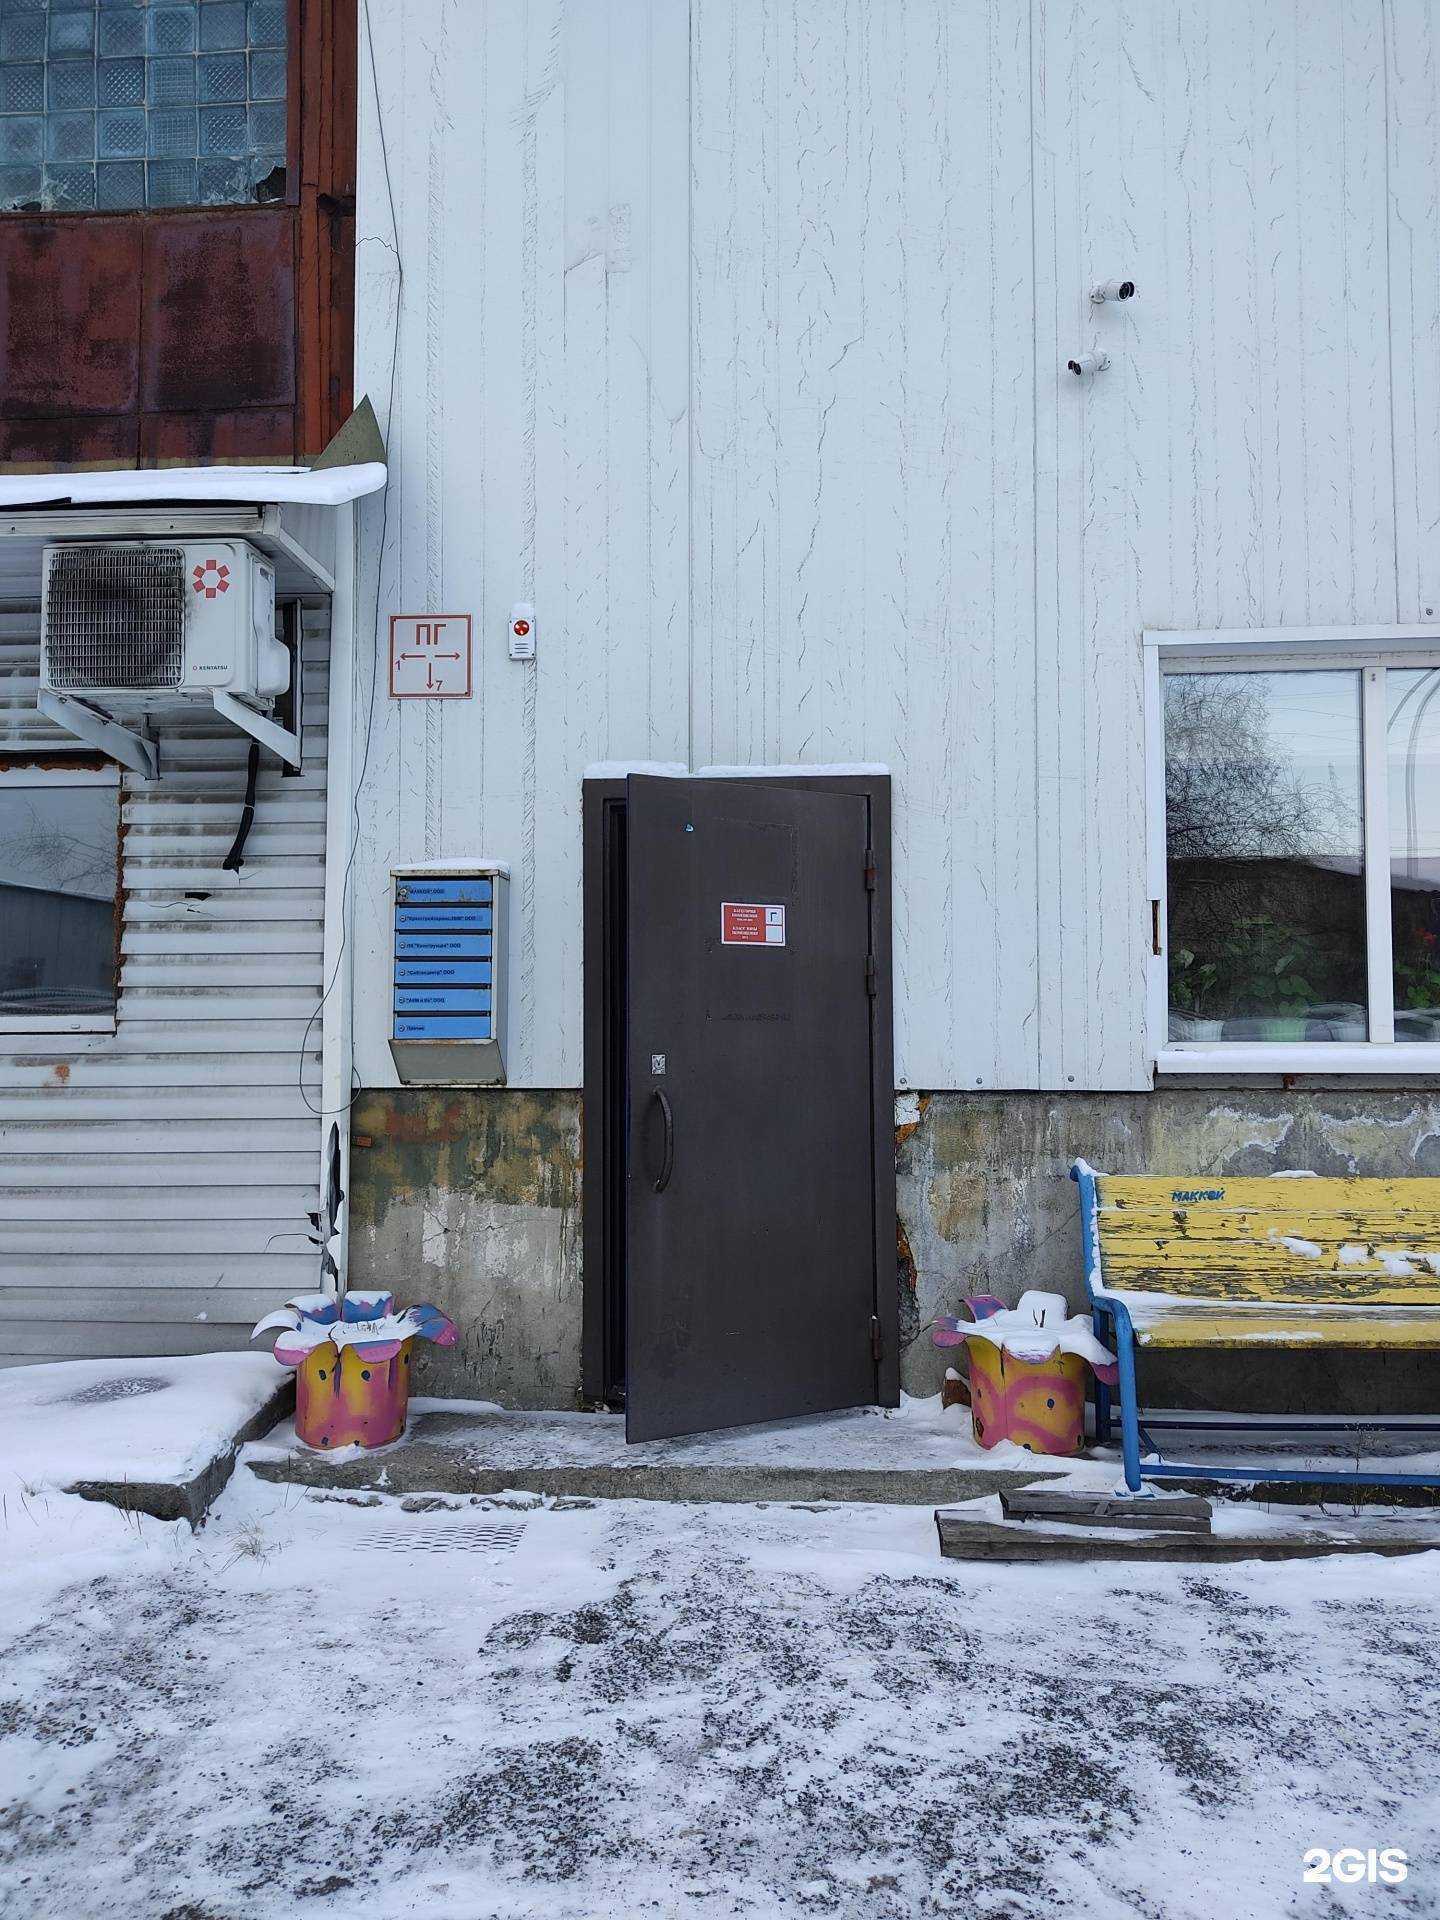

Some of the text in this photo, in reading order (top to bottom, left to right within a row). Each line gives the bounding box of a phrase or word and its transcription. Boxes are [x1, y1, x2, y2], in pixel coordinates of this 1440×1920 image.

[415, 623, 447, 645] ПГ
[394, 660, 401, 671] 1
[435, 680, 443, 691] 7
[770, 911, 778, 922] Г
